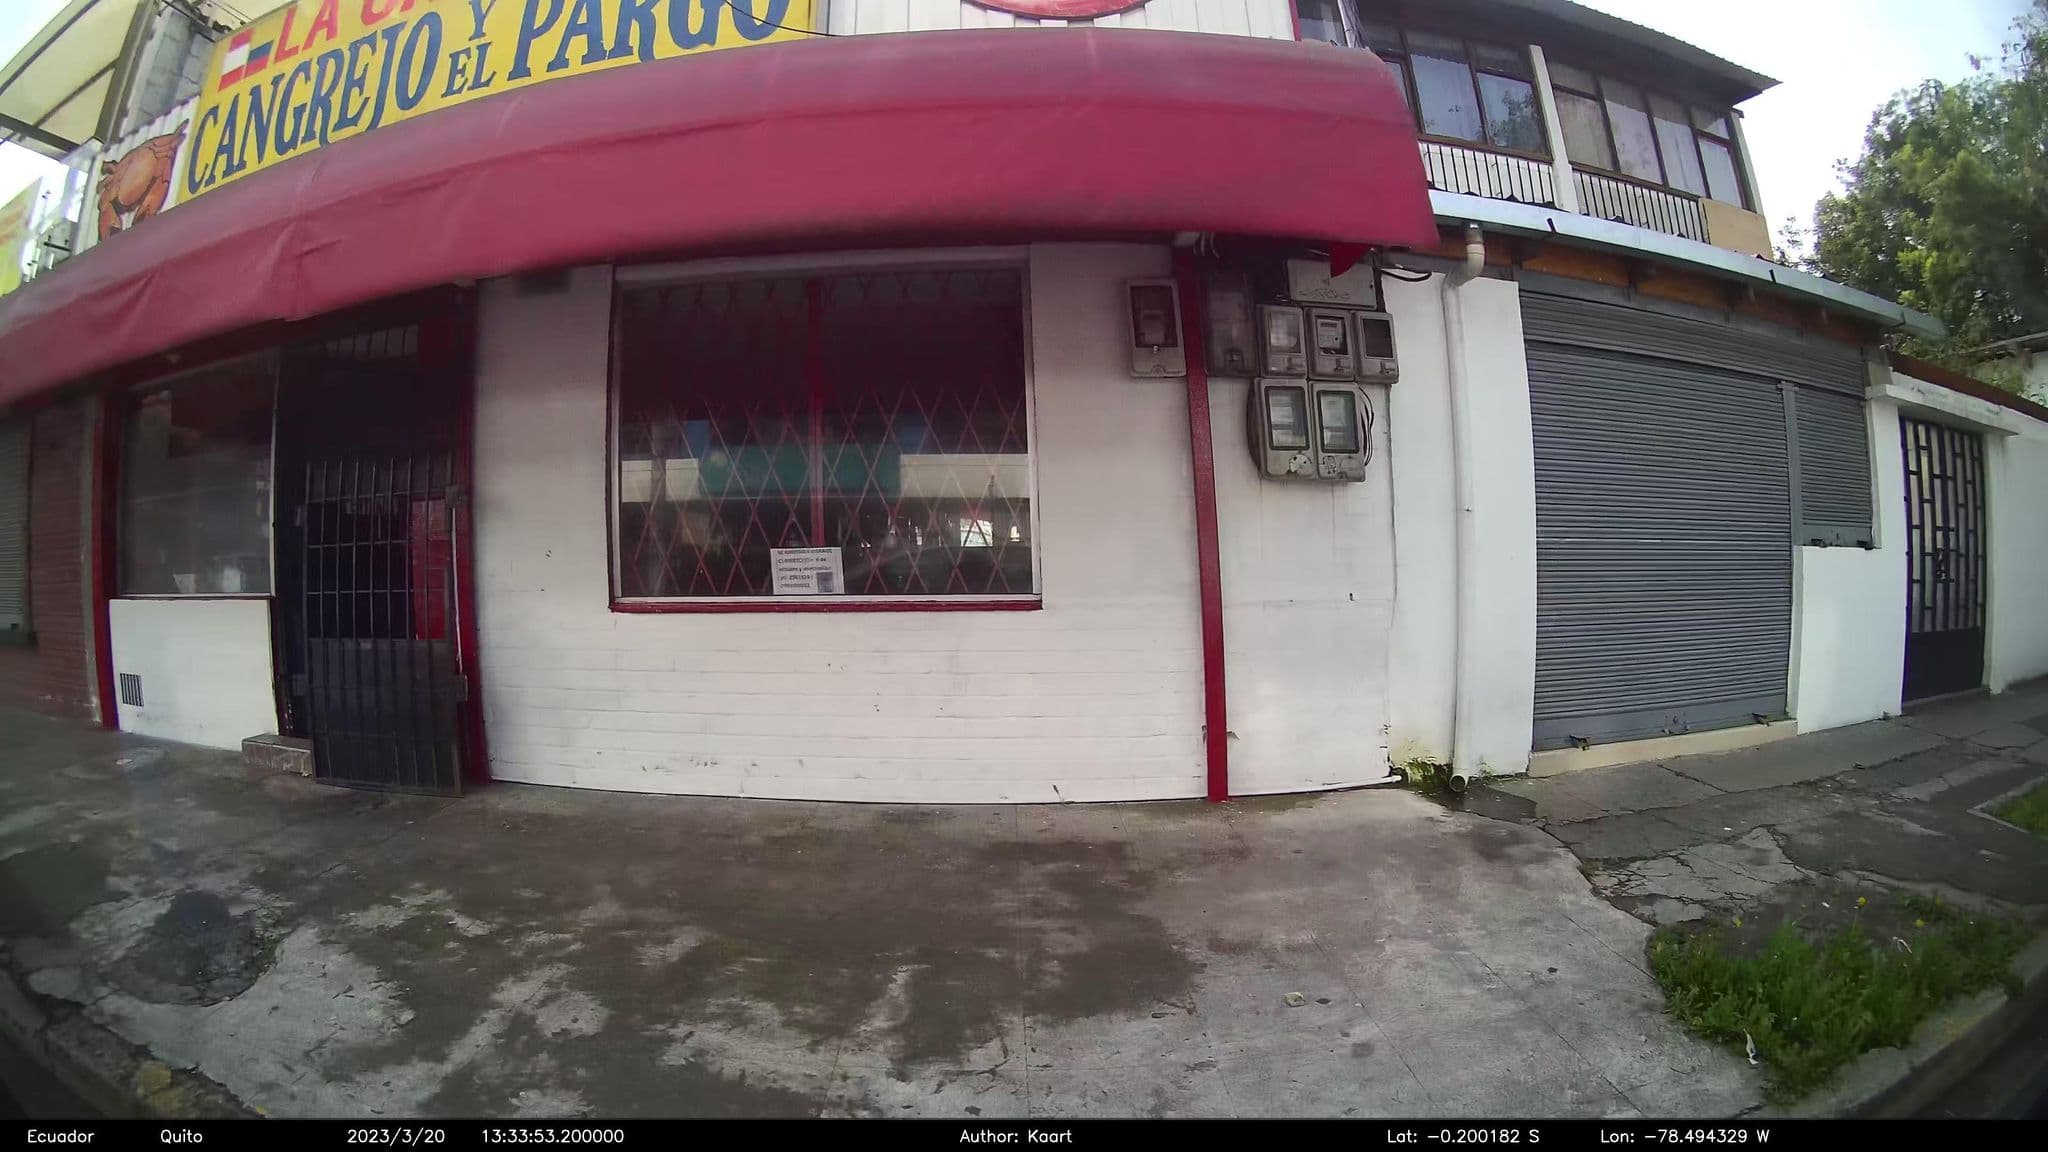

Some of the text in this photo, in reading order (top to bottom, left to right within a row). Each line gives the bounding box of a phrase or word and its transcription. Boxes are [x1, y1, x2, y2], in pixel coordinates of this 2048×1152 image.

[273, 0, 339, 64] LA
[468, 0, 498, 42] Y
[440, 41, 497, 99] EL
[187, 10, 443, 195] CANGREJO
